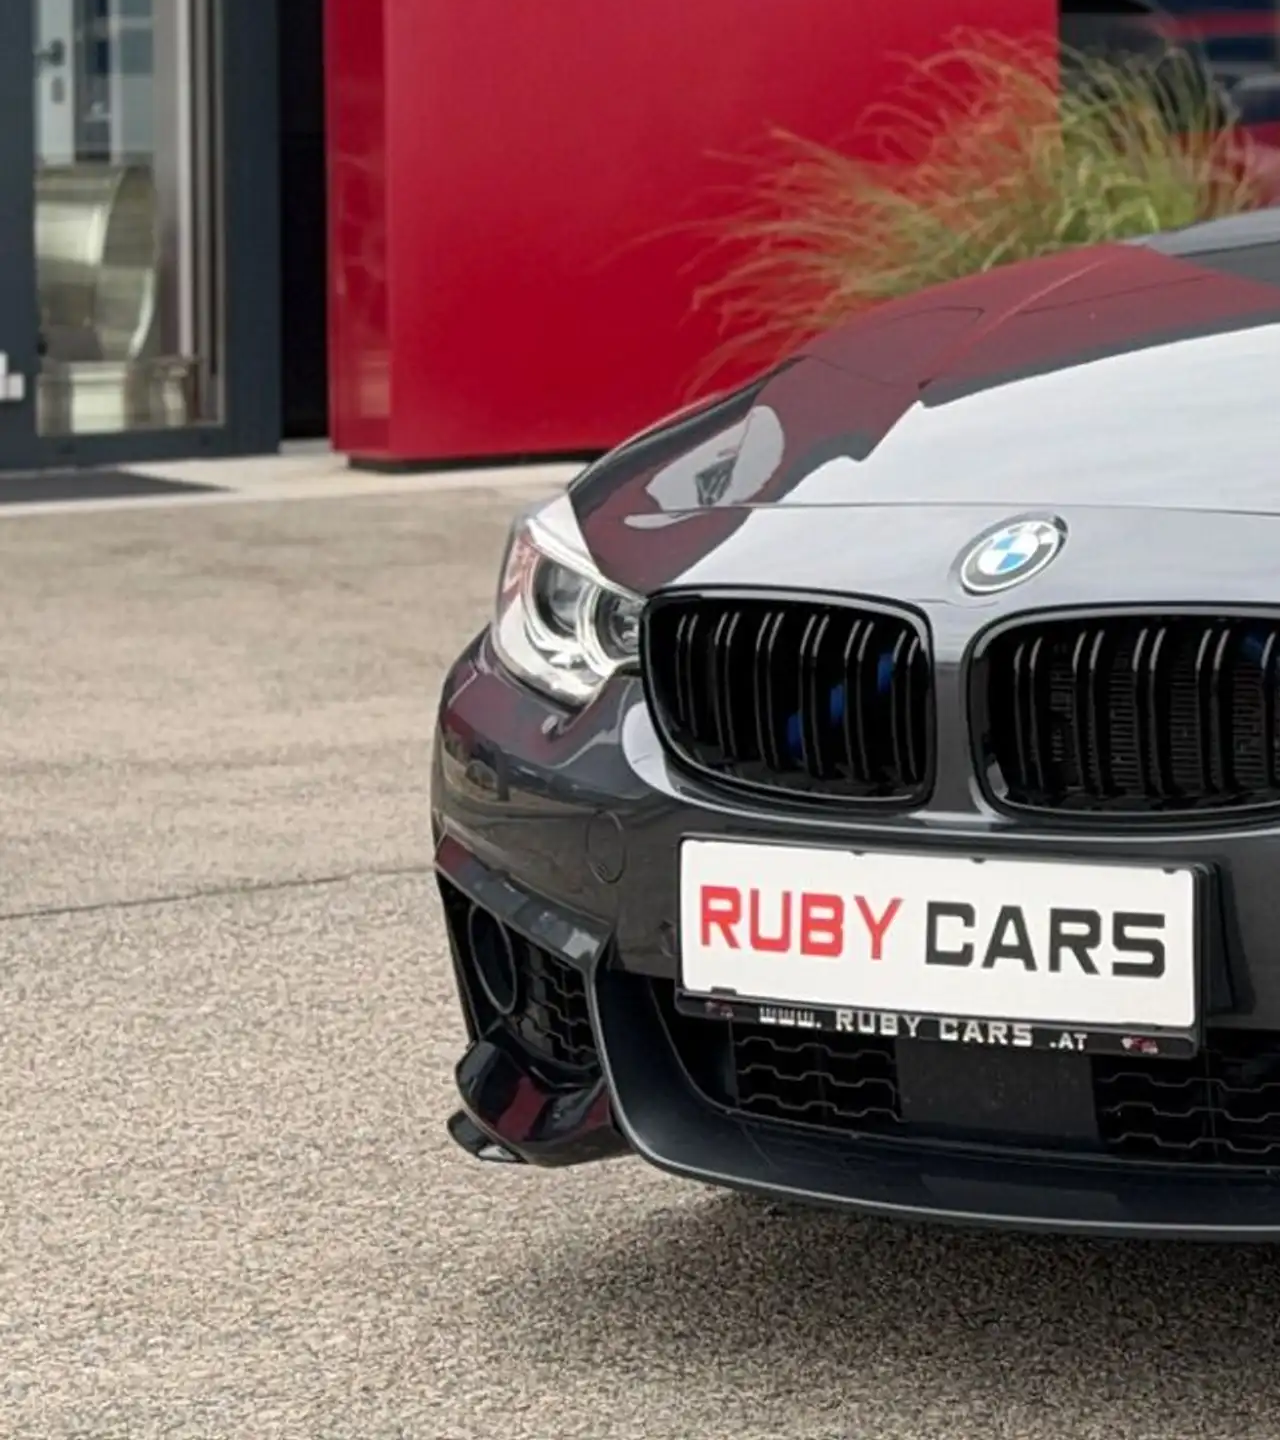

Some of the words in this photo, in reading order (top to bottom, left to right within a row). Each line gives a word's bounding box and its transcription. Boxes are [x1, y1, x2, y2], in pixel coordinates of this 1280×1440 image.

[699, 885, 902, 960] RUBY
[925, 899, 1166, 978] CARS
[835, 1009, 922, 1038] RUBY
[938, 1017, 1033, 1048] CARS
[1049, 1031, 1089, 1051] .AT
